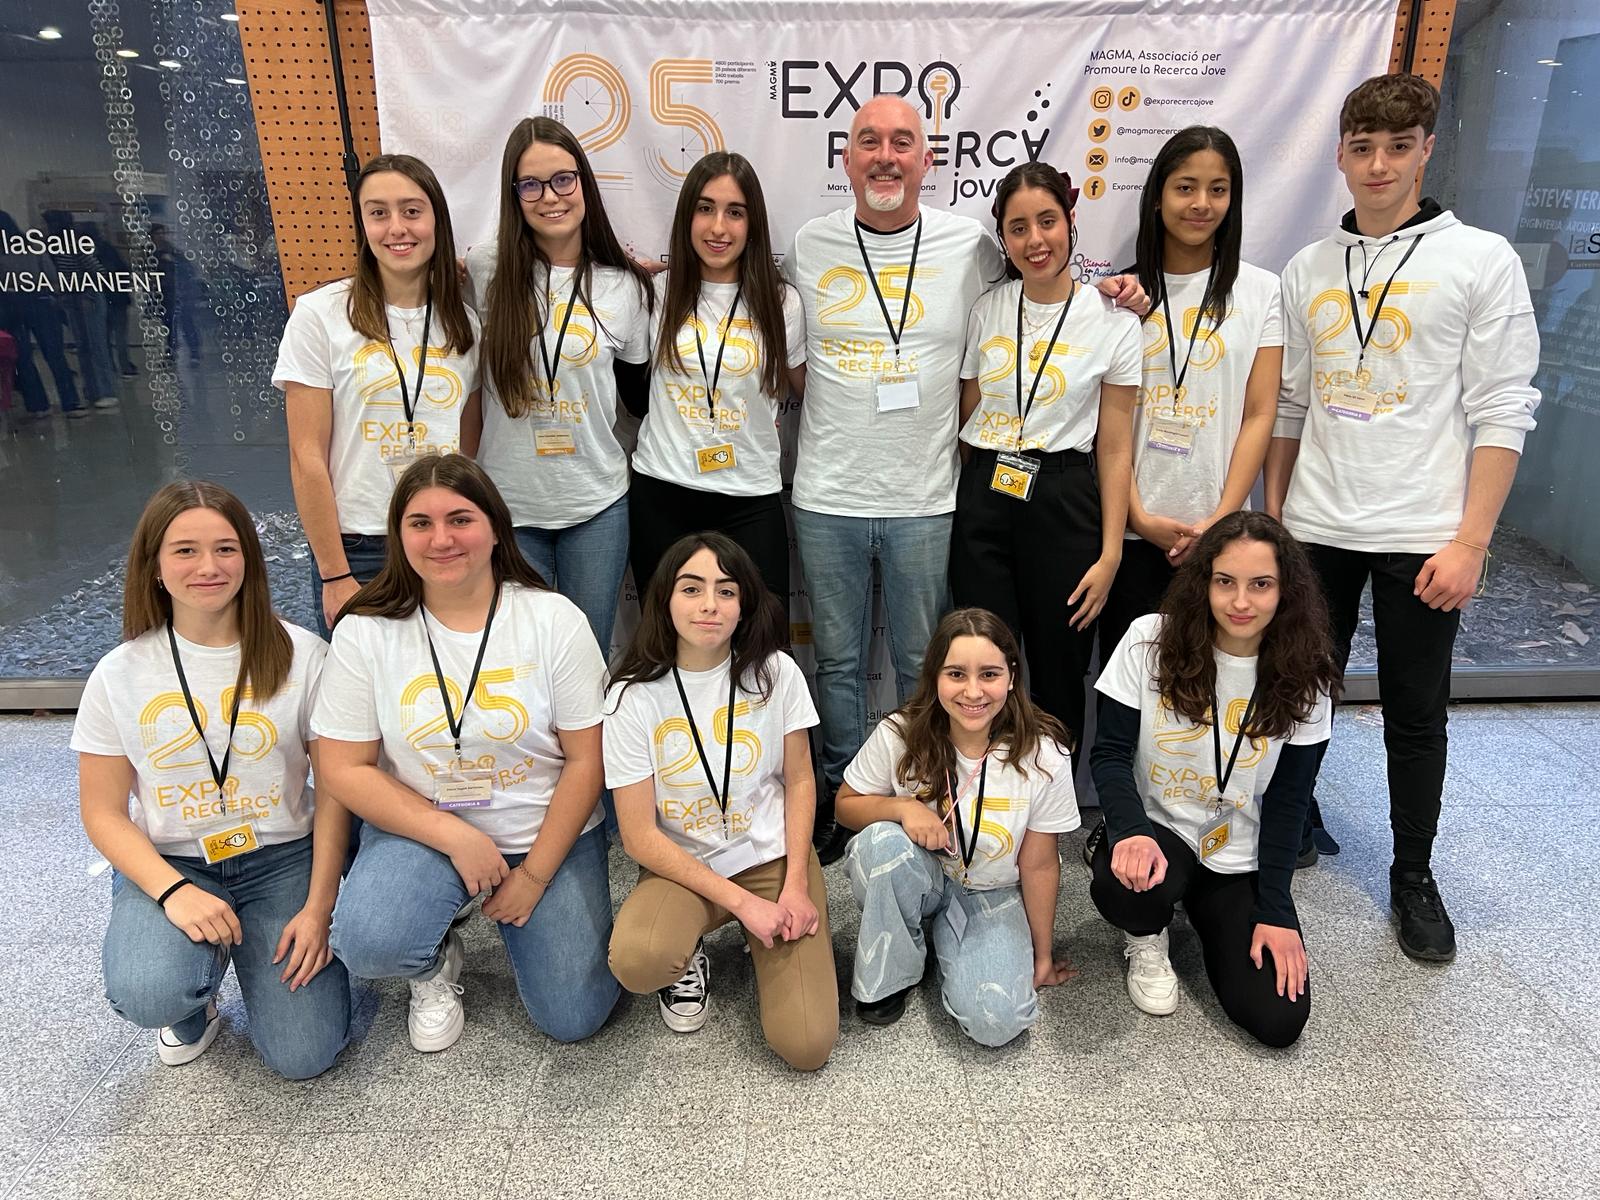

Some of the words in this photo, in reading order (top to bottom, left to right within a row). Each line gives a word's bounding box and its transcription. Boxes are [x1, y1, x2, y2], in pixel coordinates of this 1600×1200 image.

[1090, 50, 1135, 62] MAGMA,
[1138, 50, 1199, 62] Associació
[1202, 53, 1221, 63] per
[1084, 65, 1137, 76] Promoure
[1140, 65, 1151, 75] la
[1153, 65, 1198, 76] Recerca
[1201, 65, 1226, 76] Jove
[782, 60, 961, 119] EXPO
[1143, 97, 1214, 108] @exporecercajove
[543, 53, 727, 182] 25
[828, 128, 1050, 168] RERCA
[1114, 156, 1156, 165] info@mag
[827, 184, 848, 193] Març
[950, 171, 1003, 206] jov
[1112, 183, 1146, 193] Exporec
[1574, 189, 1600, 210] TER
[2, 229, 95, 255] laSalle
[1083, 259, 1111, 267] Ciencia
[58, 272, 165, 292] MANENT
[817, 264, 925, 330] 25
[1307, 281, 1412, 356] 25
[822, 338, 886, 357] EXPO
[975, 410, 1025, 432] XPO
[400, 667, 530, 752] 25
[139, 684, 279, 770] 25
[654, 701, 762, 787] 25
[156, 776, 241, 808] EXPO
[683, 806, 755, 833] RECERC
[731, 824, 751, 834] jov
